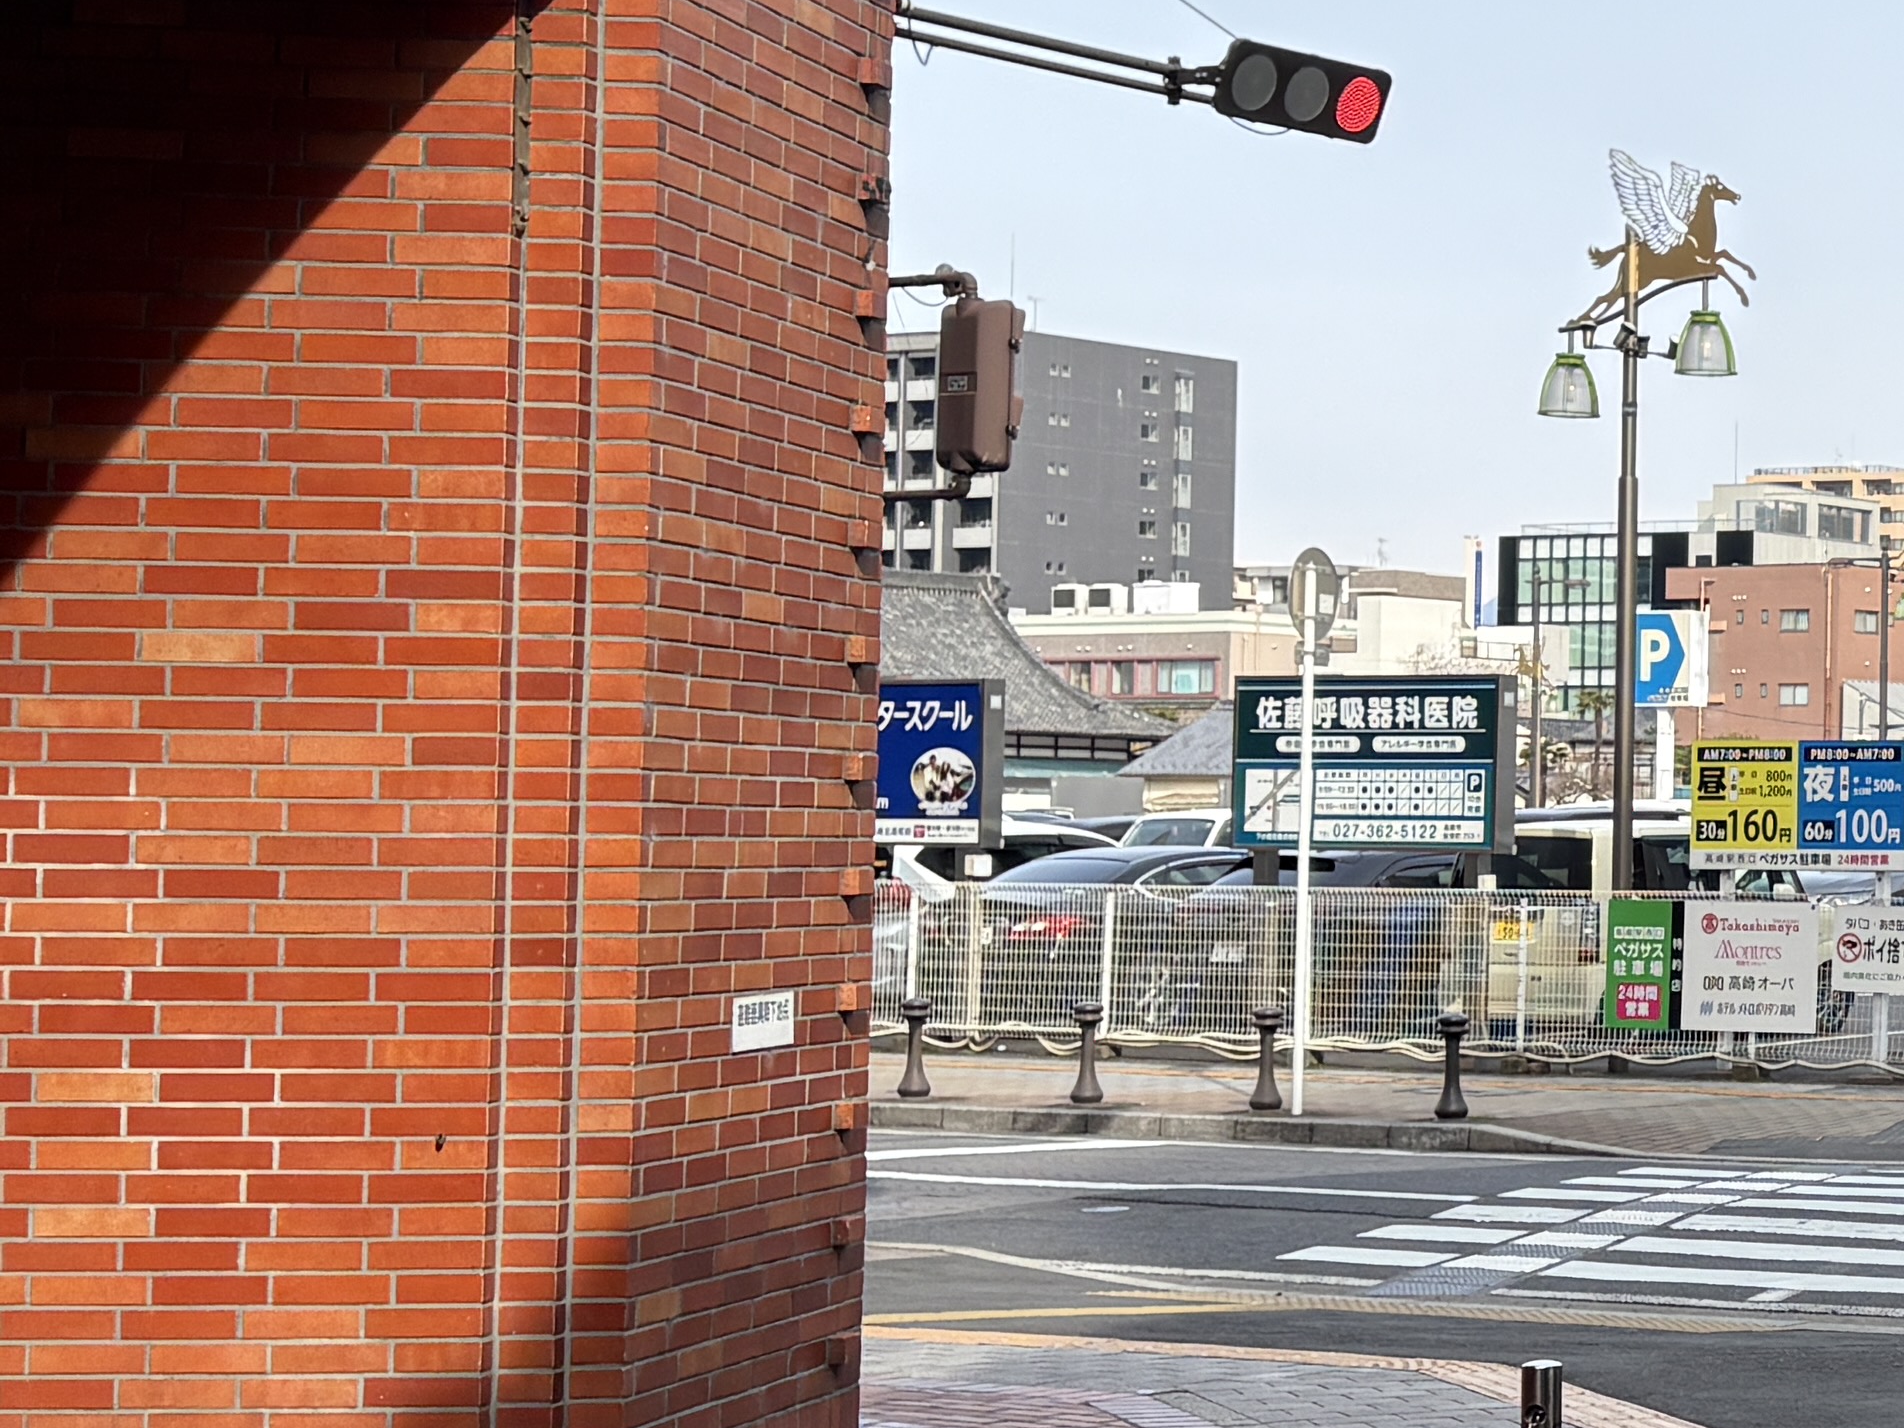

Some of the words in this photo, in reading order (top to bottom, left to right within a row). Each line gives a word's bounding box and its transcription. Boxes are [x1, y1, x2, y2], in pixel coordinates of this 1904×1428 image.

[1640, 629, 1671, 682] P
[1697, 766, 1727, 801] 昼
[1803, 765, 1835, 803] 夜
[1332, 823, 1438, 839] 027-362-5122
[1699, 821, 1726, 840] 30分
[1727, 808, 1792, 843] 160円
[1804, 821, 1834, 841] 60分
[1835, 808, 1901, 844] 100円
[1760, 853, 1832, 866] ペガサス駐車場
[1720, 919, 1800, 935] Takashimaya
[1614, 942, 1665, 958] ペガサス
[1714, 939, 1783, 960] Montres
[1613, 960, 1664, 977] 駐車場
[1618, 984, 1658, 1001] 24時間
